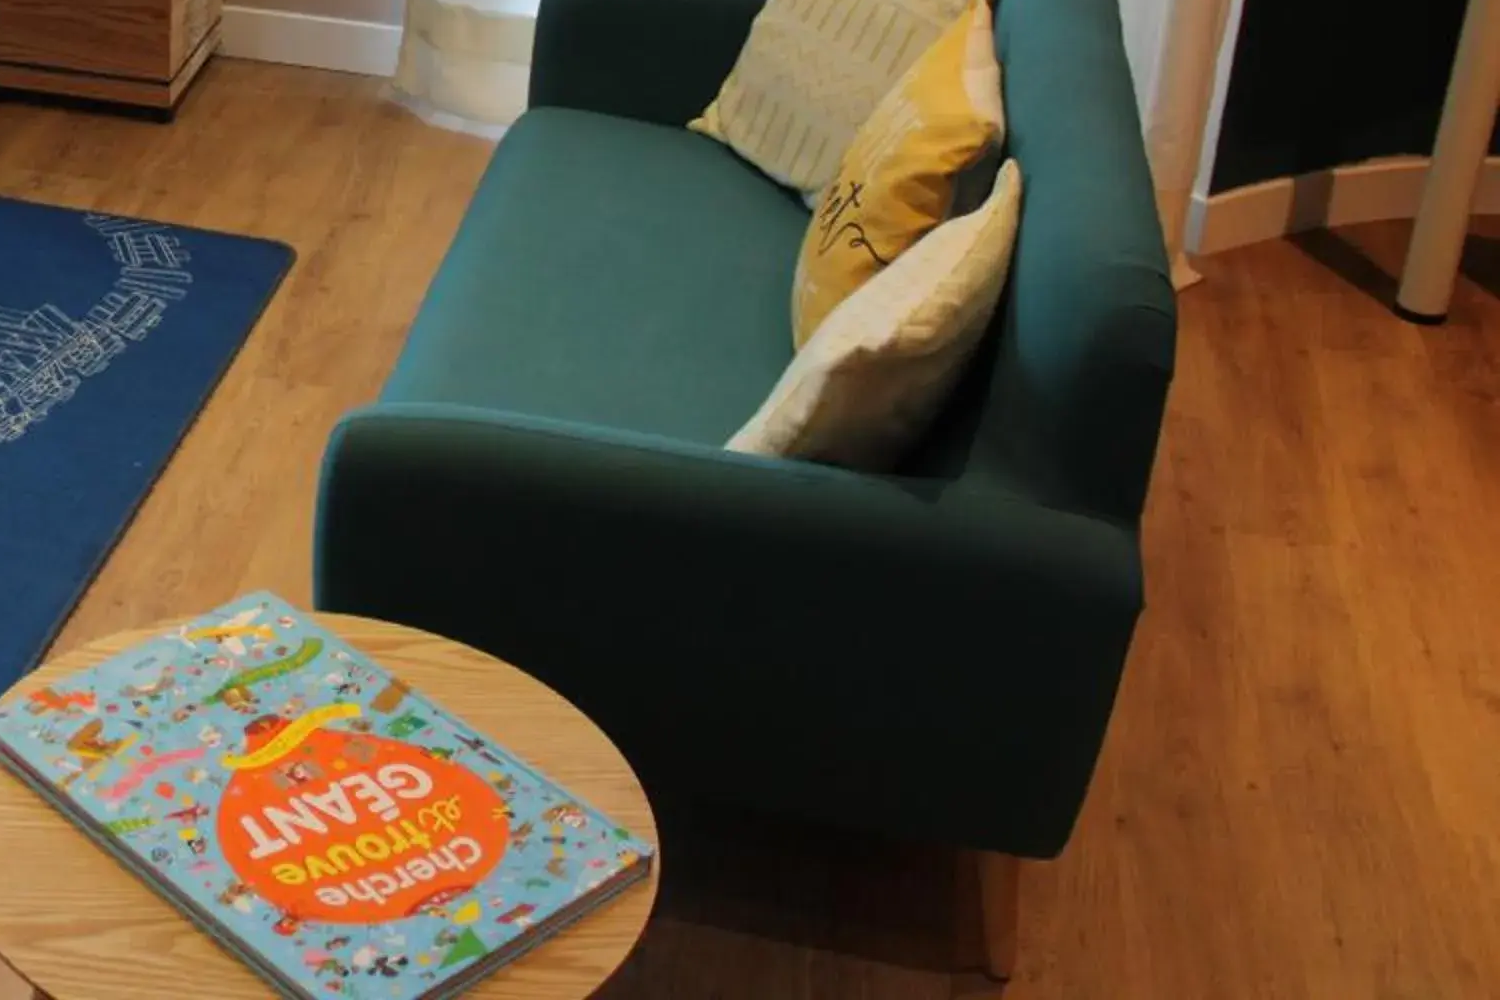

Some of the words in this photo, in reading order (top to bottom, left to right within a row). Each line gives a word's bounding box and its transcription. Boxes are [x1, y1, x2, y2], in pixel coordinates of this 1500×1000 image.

[240, 763, 434, 860] GÉANT
[271, 819, 433, 885] trouve
[314, 835, 483, 906] Cherche
